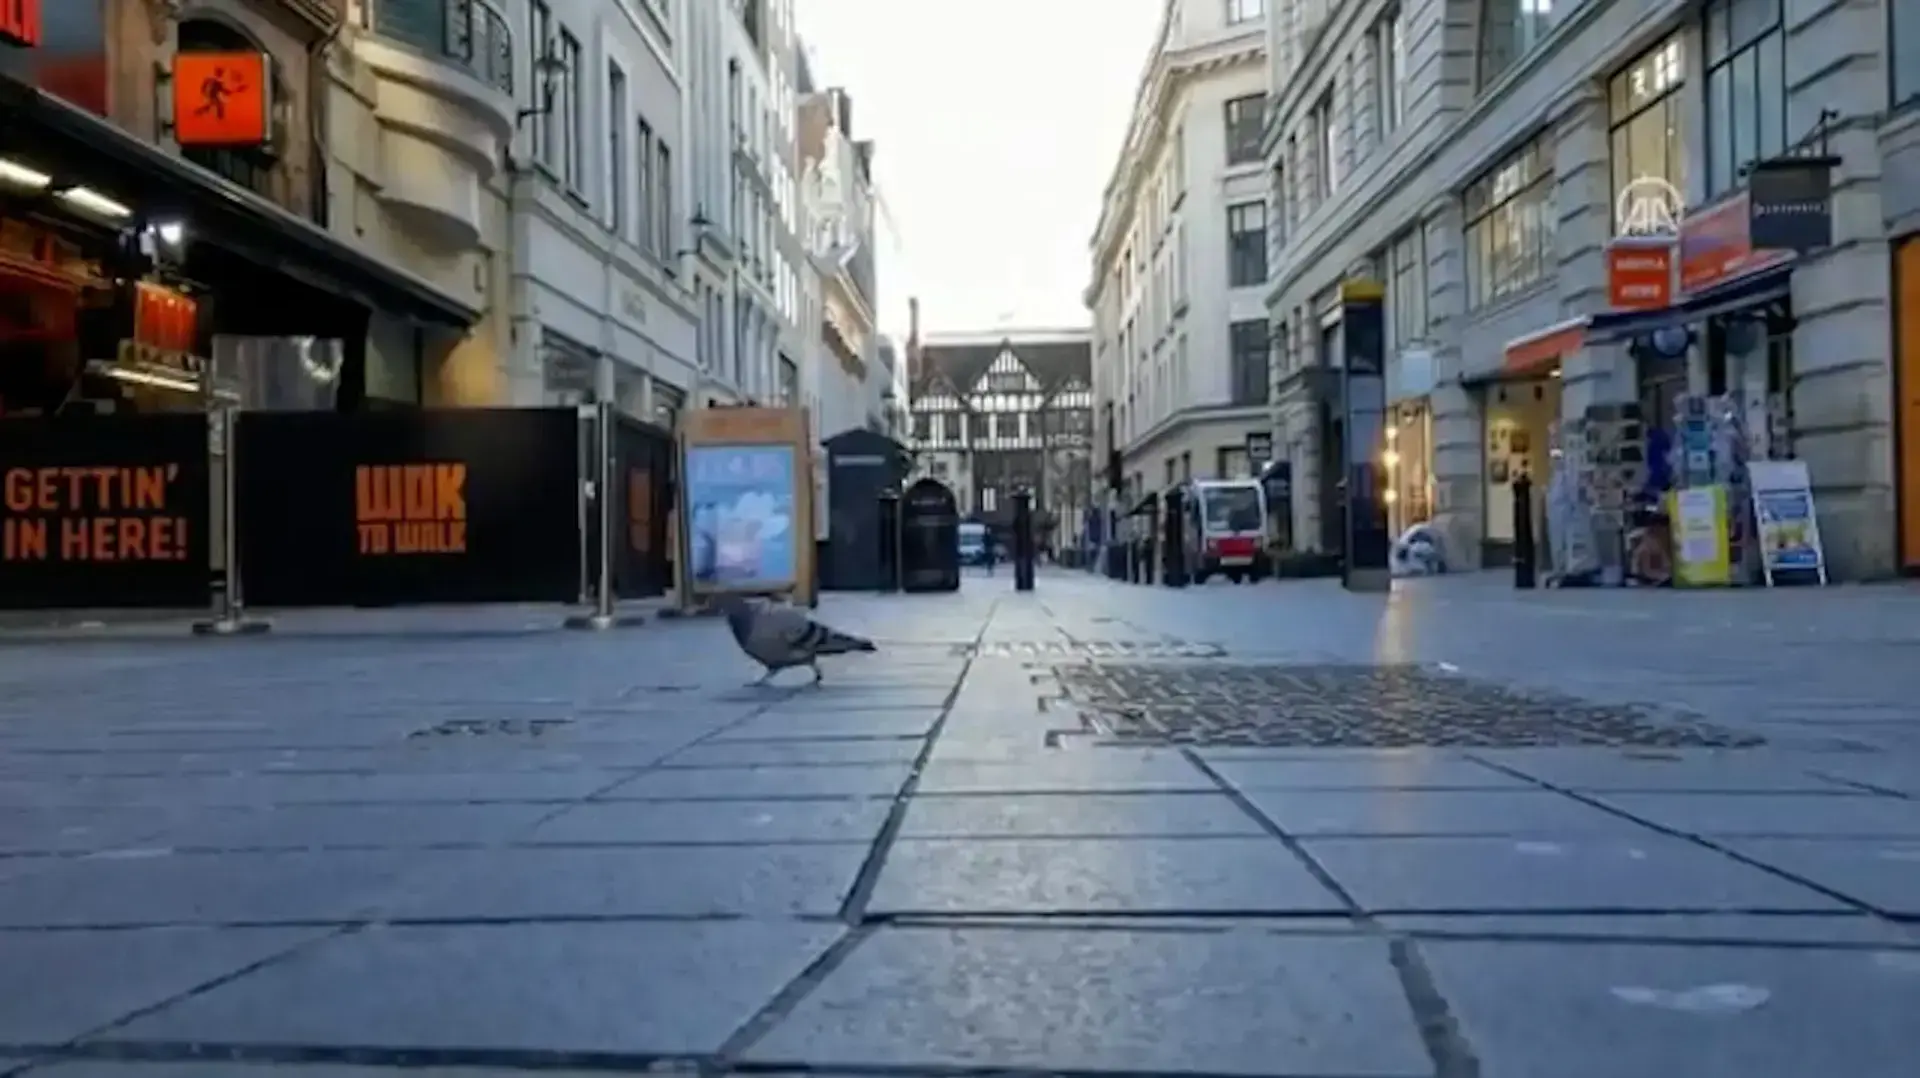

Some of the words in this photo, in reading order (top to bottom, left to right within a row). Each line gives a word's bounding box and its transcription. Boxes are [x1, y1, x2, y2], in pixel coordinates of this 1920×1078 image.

[5, 463, 179, 511] GETTIN'
[356, 463, 466, 520] WOK
[4, 517, 47, 561] IN
[61, 517, 188, 561] HERE!
[357, 524, 388, 554] TO
[394, 522, 466, 553] WALK
